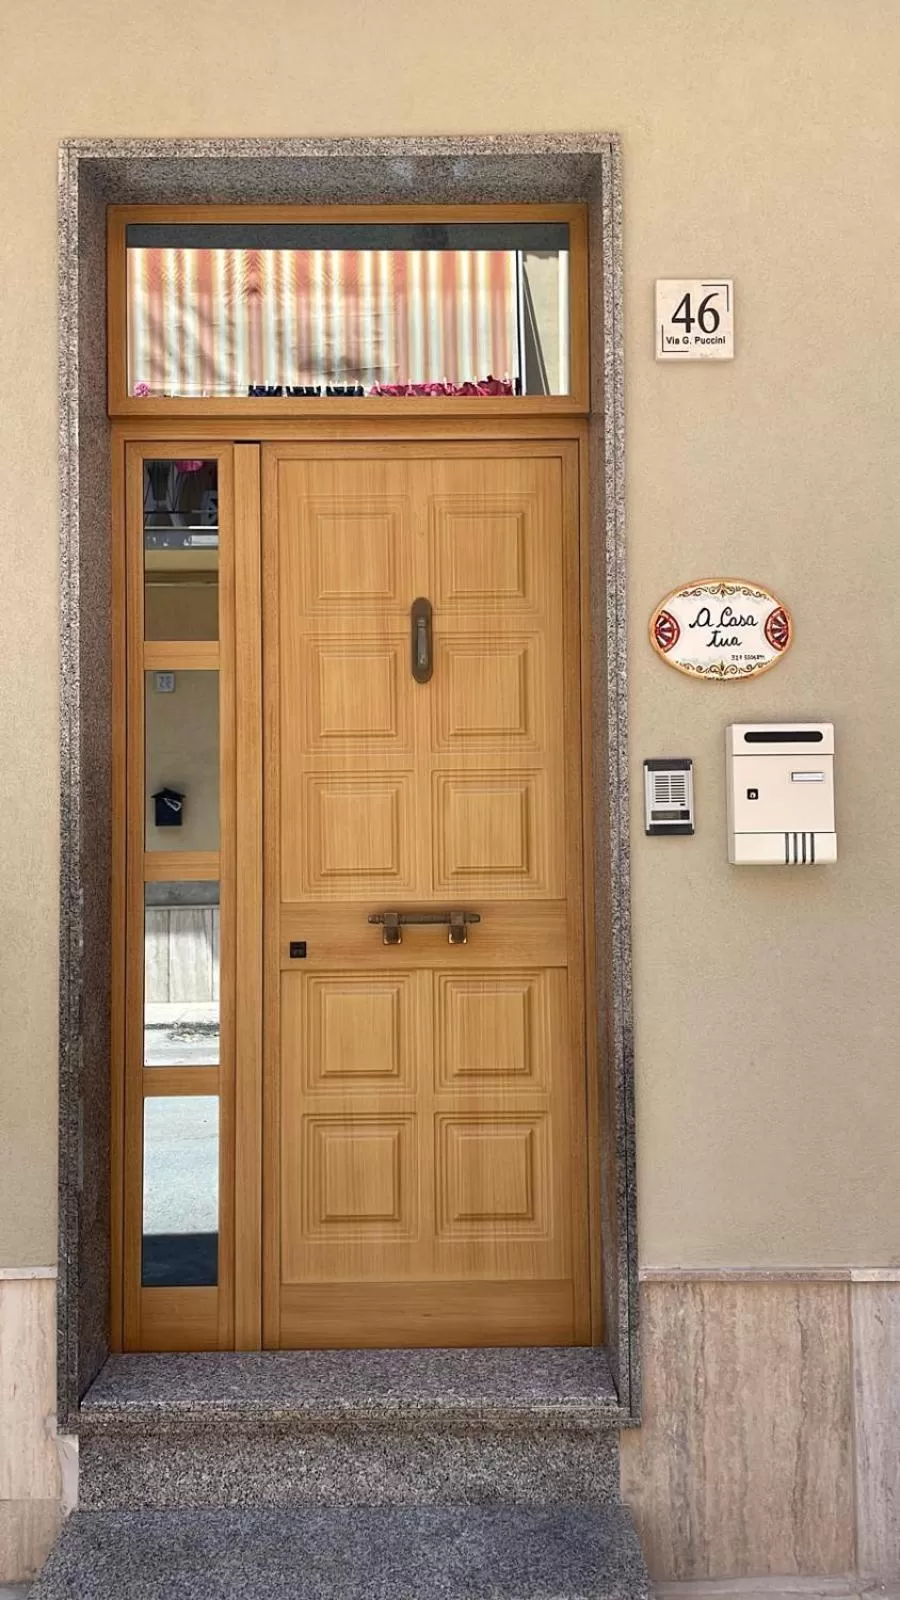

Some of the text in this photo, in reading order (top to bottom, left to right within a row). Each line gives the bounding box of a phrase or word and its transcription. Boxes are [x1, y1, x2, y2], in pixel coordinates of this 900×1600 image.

[671, 292, 720, 334] 46
[666, 336, 726, 345] Via G. Puccini
[688, 606, 759, 629] A Casa
